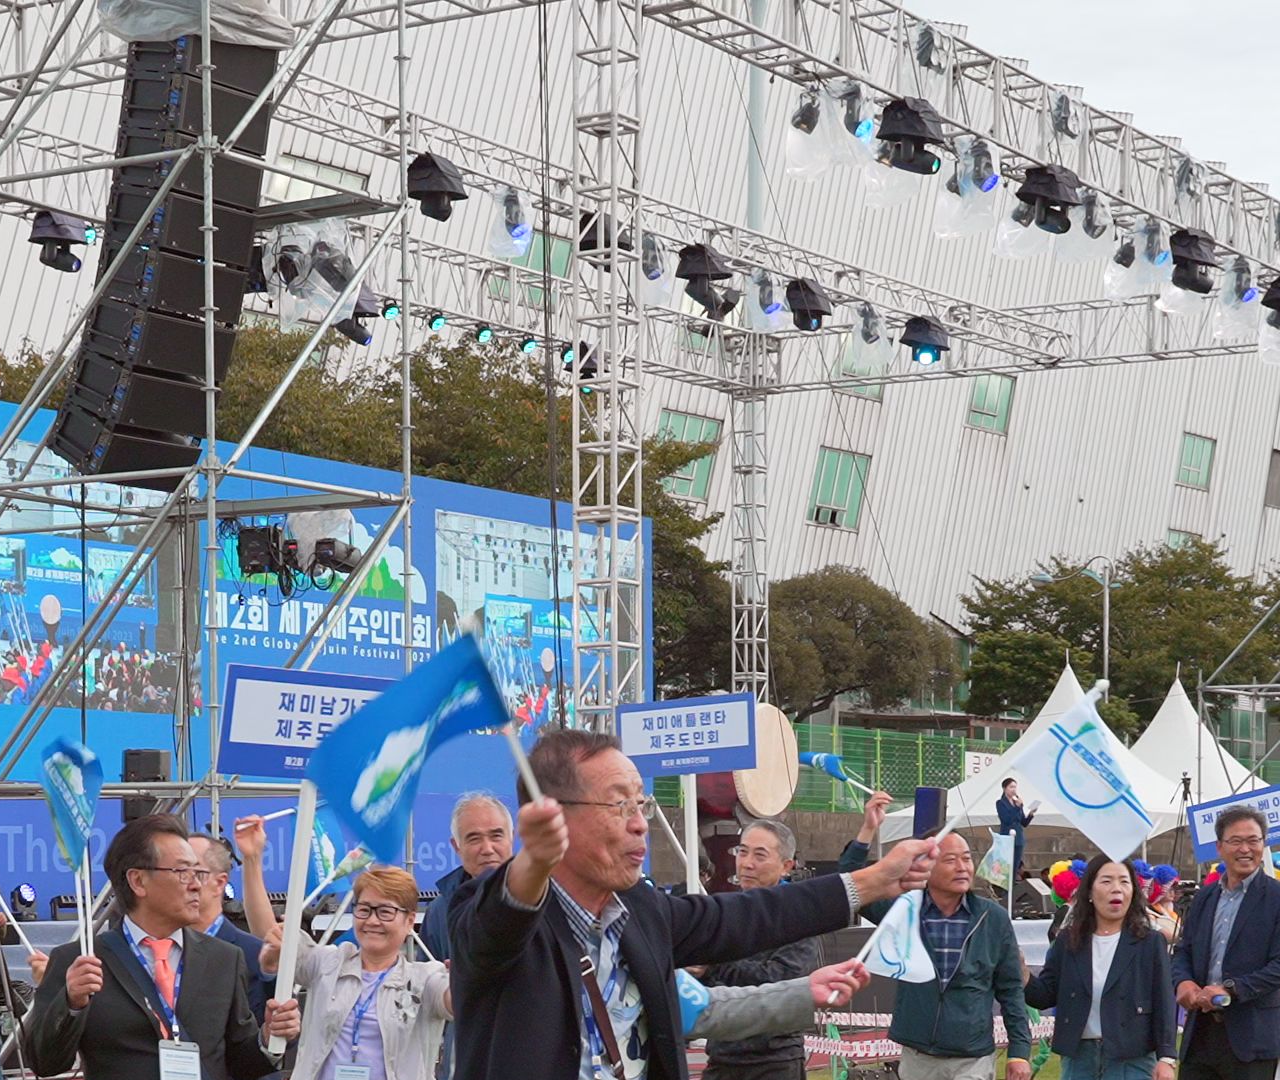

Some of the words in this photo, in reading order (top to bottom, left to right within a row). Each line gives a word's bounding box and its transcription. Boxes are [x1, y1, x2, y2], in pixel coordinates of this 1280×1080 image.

[204, 589, 269, 633] 제2회
[233, 633, 257, 647] 2nd
[262, 636, 300, 651] Globa
[353, 645, 401, 661] Festival
[278, 691, 372, 716] 재미남가
[650, 729, 719, 749] 제주도민회
